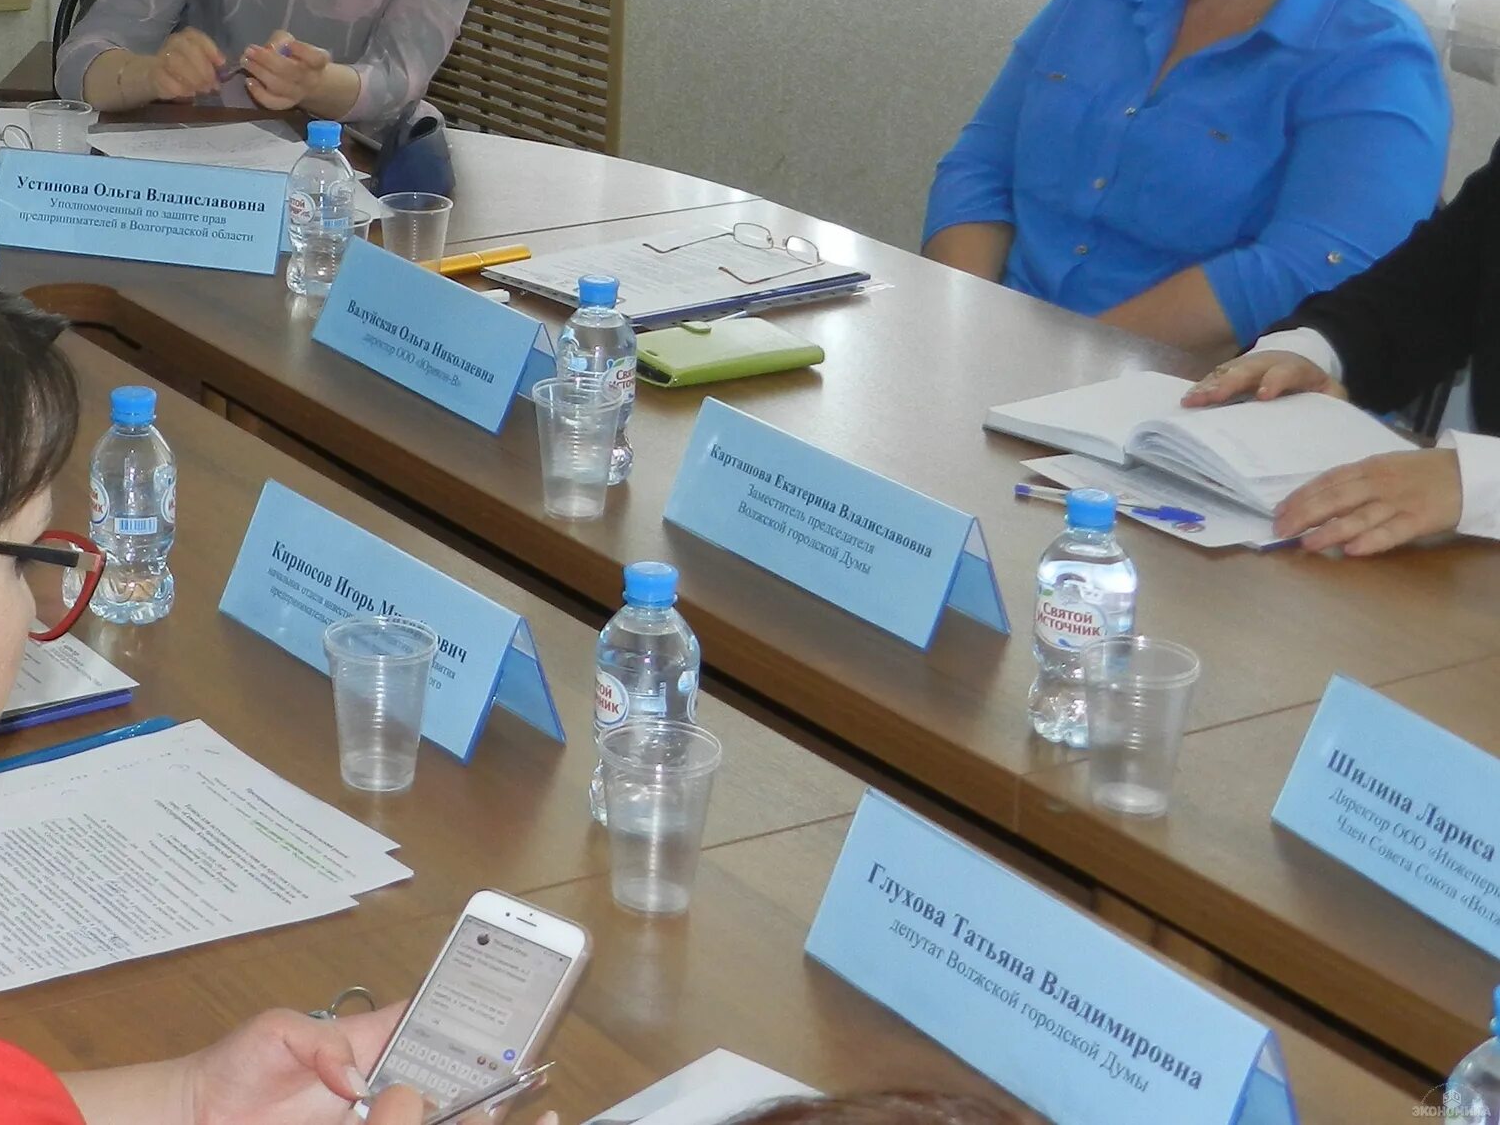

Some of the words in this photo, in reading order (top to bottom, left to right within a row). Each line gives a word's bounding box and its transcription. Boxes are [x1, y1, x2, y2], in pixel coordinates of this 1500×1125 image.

[17, 175, 89, 195] Устинова
[94, 182, 141, 200] Ольга
[146, 187, 265, 212] Владиславовна
[19, 211, 117, 229] предпринимателей
[129, 219, 209, 238] Волгоградской
[211, 229, 254, 242] области
[50, 197, 143, 216] Уполномоченный
[145, 208, 159, 218] по
[202, 214, 227, 225] прав
[347, 299, 398, 336] Валуйская
[399, 325, 431, 351] Ольга
[432, 341, 495, 383] Николаевна
[710, 443, 773, 484] Карташова
[774, 473, 837, 514] Екатерина
[839, 503, 933, 558] Владиславовна
[737, 500, 788, 535] Волжской
[787, 526, 840, 560] городской
[839, 550, 872, 575] Думы
[747, 483, 806, 522] Заместитель
[807, 515, 875, 555] председателя
[272, 539, 333, 587] Кирносов
[334, 575, 375, 612] Игорь
[1327, 748, 1414, 814] Шилина
[1415, 802, 1496, 862] Лариса
[1328, 787, 1391, 833] Директор
[1392, 822, 1427, 851] ООО
[1336, 814, 1369, 844] Член
[1369, 835, 1414, 872] Совета
[1414, 863, 1459, 899] Союза
[867, 861, 946, 928] Глухова
[952, 912, 1035, 984] Татьяна
[1039, 970, 1203, 1090] Владимировна
[889, 918, 946, 960] депутат
[946, 950, 1021, 1008] Волжской
[1020, 1002, 1101, 1061] городской
[1099, 1050, 1150, 1093] Думы
